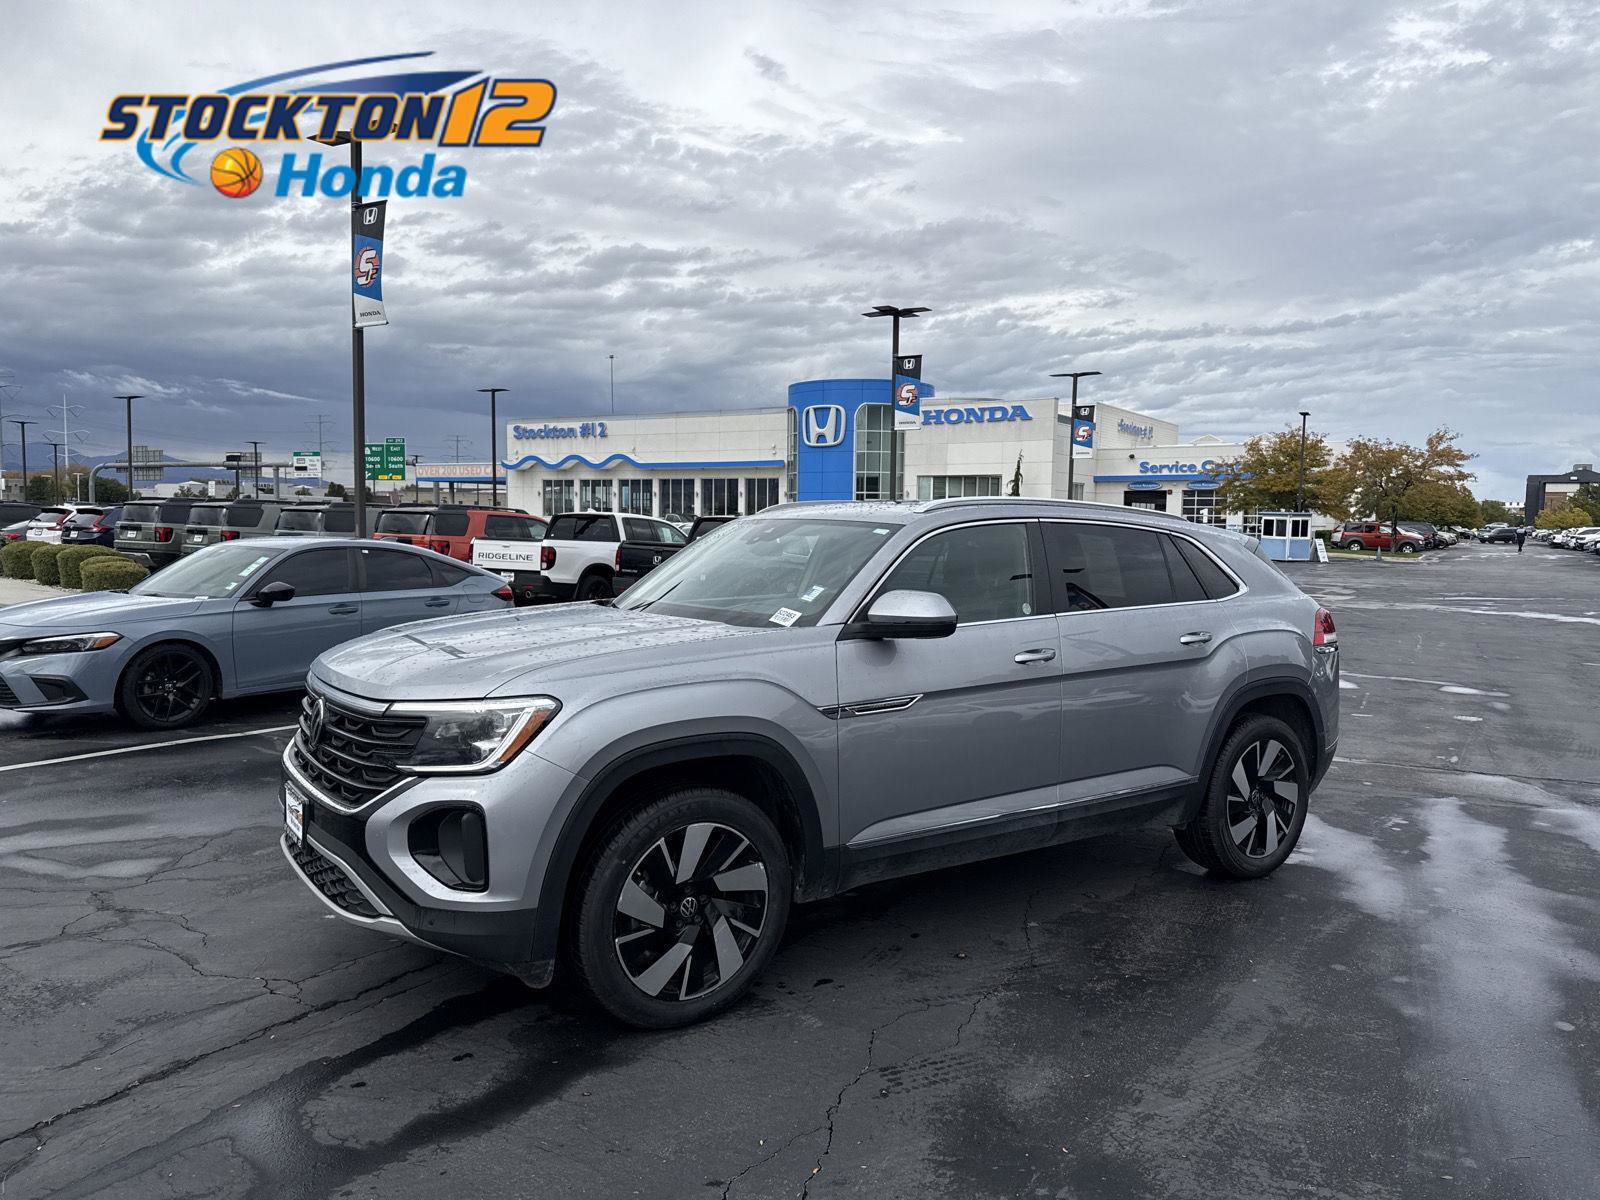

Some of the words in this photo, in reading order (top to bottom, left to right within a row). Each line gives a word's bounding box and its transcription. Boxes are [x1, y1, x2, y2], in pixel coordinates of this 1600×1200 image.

[922, 405, 1033, 425] HONDA
[513, 424, 577, 440] Stockton
[579, 422, 608, 438] #12
[417, 465, 440, 476] OVER
[442, 465, 457, 476] 200
[459, 464, 482, 475] USED
[1139, 460, 1198, 474] Service
[478, 552, 534, 561] RIDGELINE
